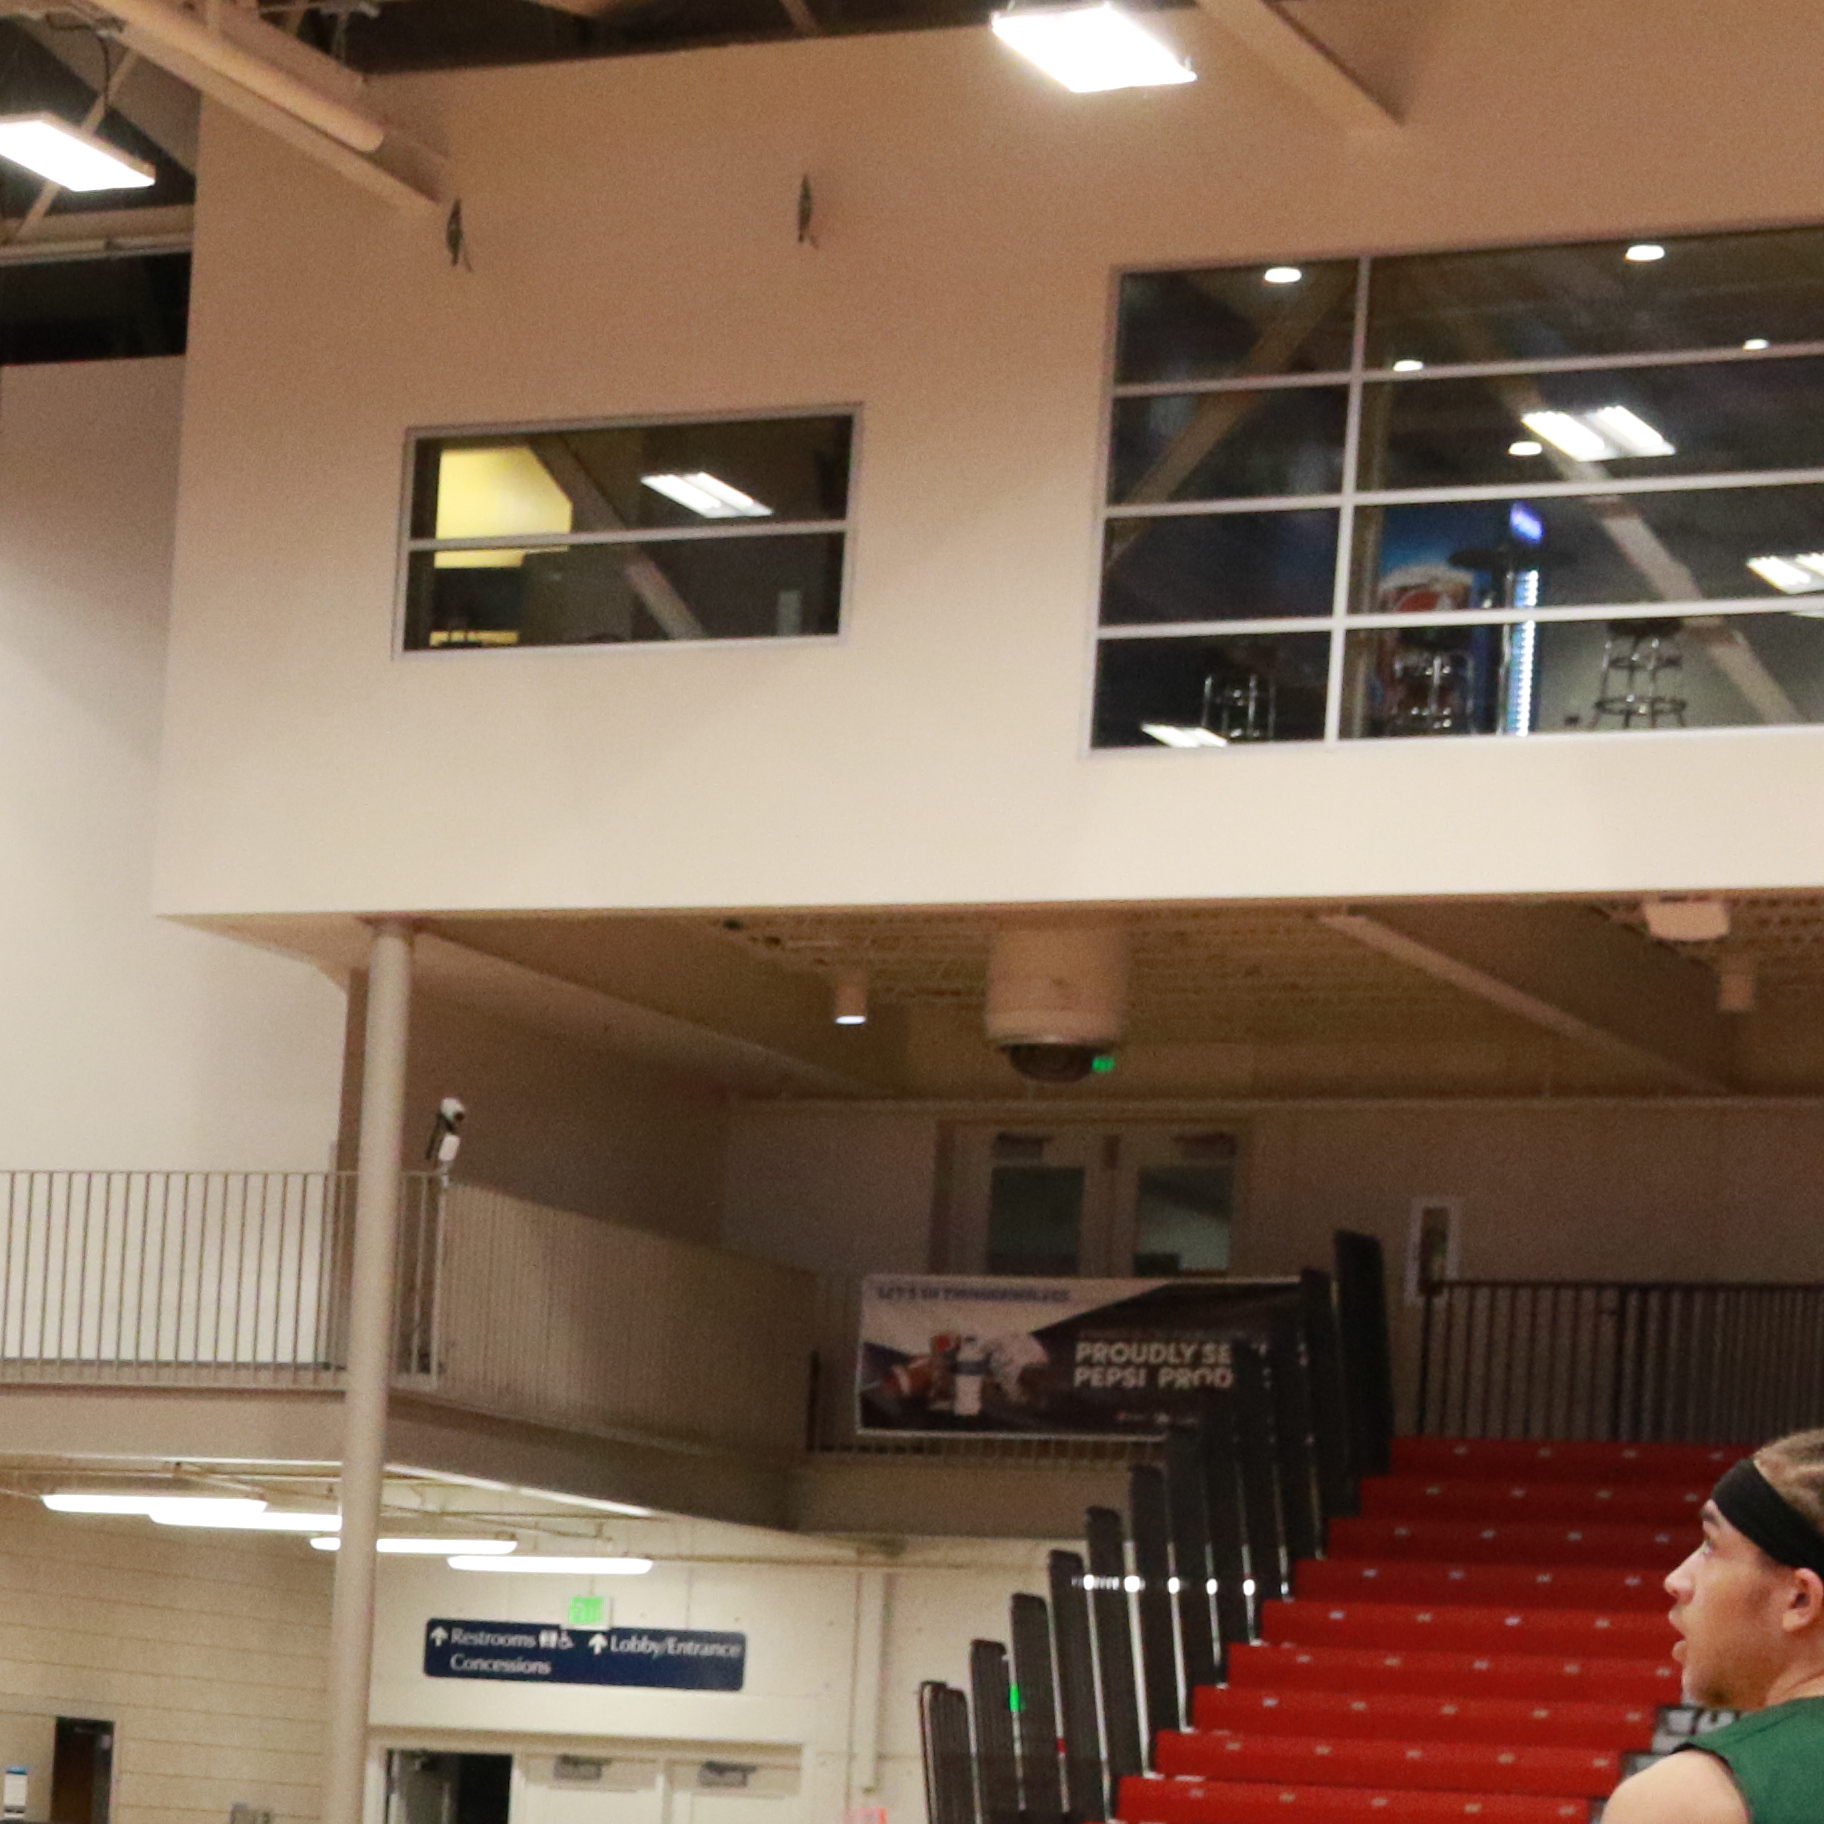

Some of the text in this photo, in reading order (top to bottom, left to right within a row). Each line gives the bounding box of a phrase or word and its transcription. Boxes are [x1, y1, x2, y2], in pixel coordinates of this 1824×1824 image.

[1075, 1340, 1193, 1365] PROUDLY
[1073, 1366, 1235, 1390] PEPSI PROD
[451, 1626, 743, 1660] Restrooms Lobby/Entrance
[449, 1653, 552, 1676] Concessions
